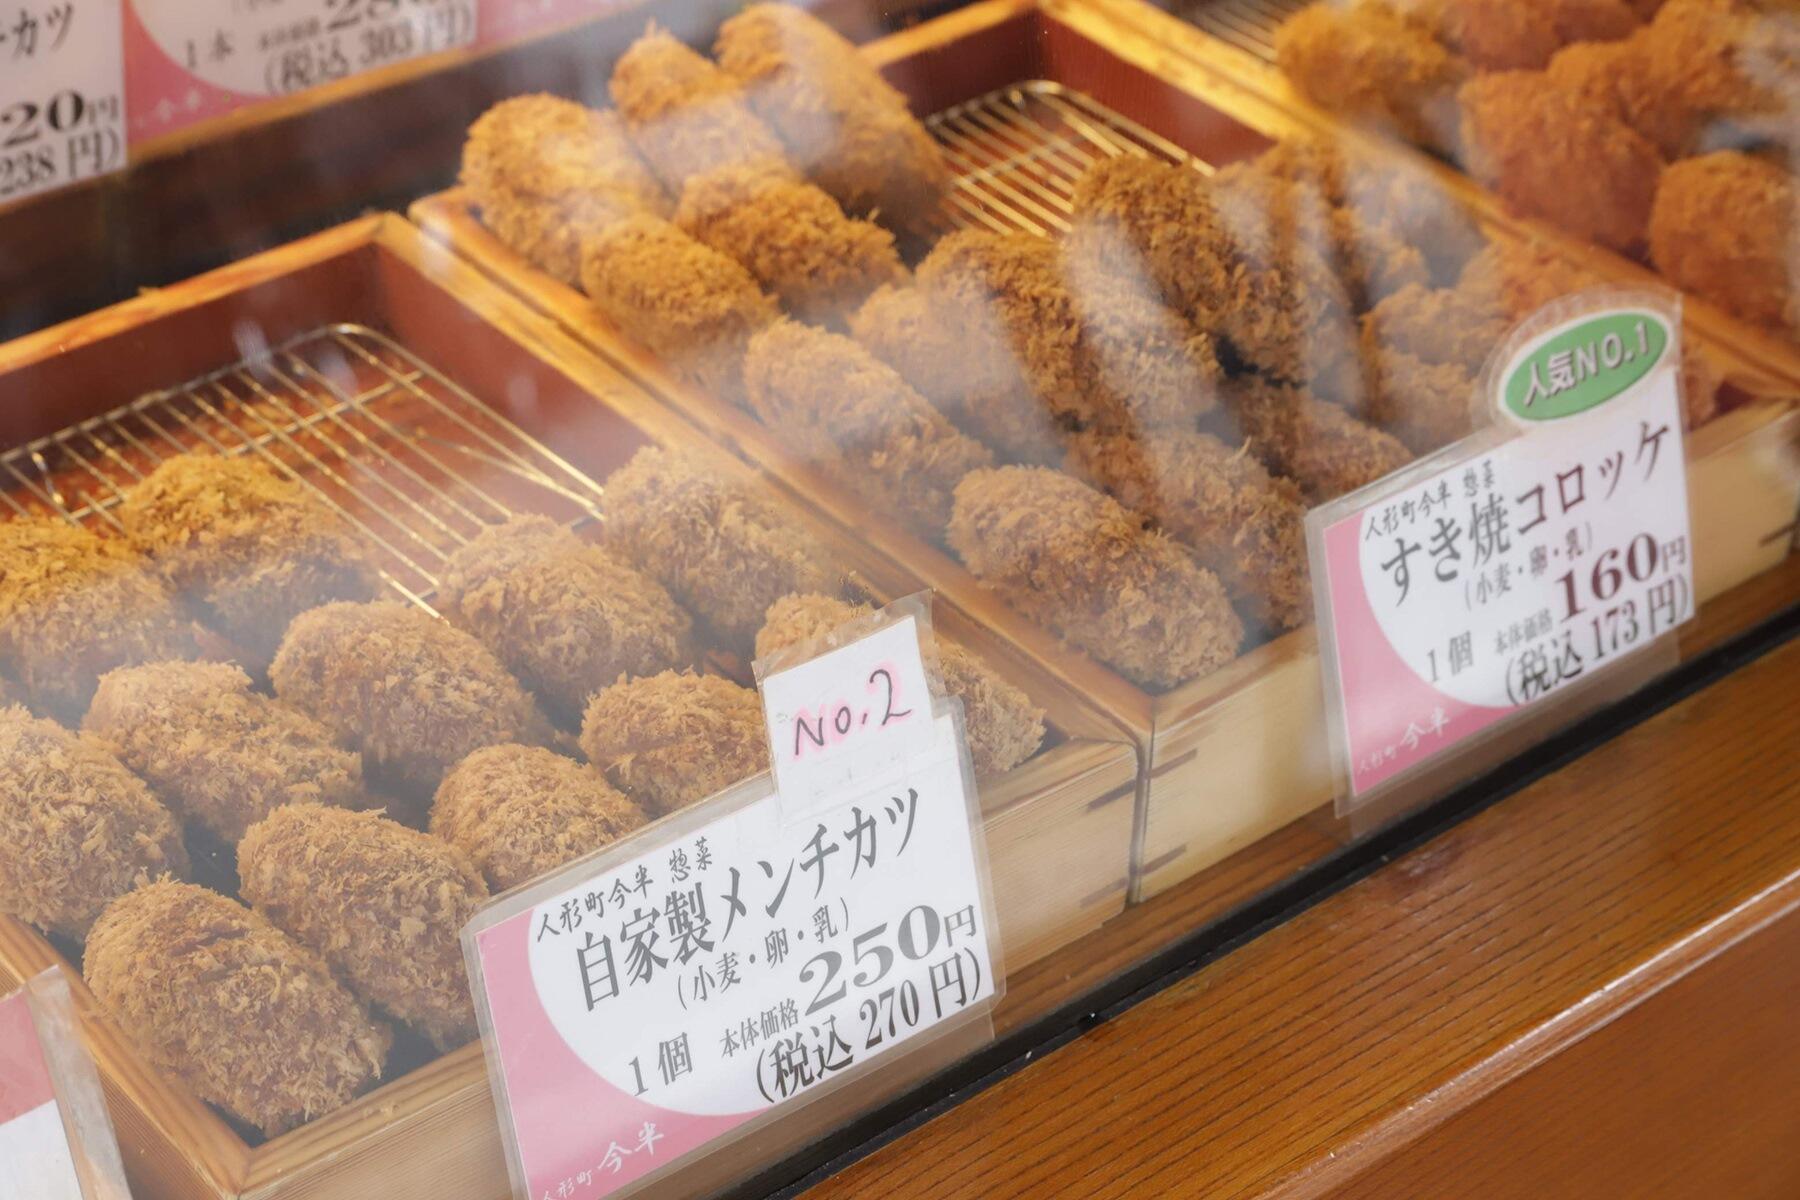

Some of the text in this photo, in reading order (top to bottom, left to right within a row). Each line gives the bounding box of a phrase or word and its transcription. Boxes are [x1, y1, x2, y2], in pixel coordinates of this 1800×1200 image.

[0, 3, 73, 61] カツ
[1524, 322, 1649, 408] 人気NO.1
[1365, 480, 1451, 541] 人形町今半
[1381, 421, 1669, 607] すき焼コロッケ
[1555, 532, 1687, 623] 160円
[538, 865, 653, 943] 人形町今半
[577, 788, 918, 1012] 自家製メンチカツ
[677, 897, 849, 1010] (小麦・卵・乳)
[720, 998, 799, 1058] 本体価格
[799, 904, 976, 1016] 250円
